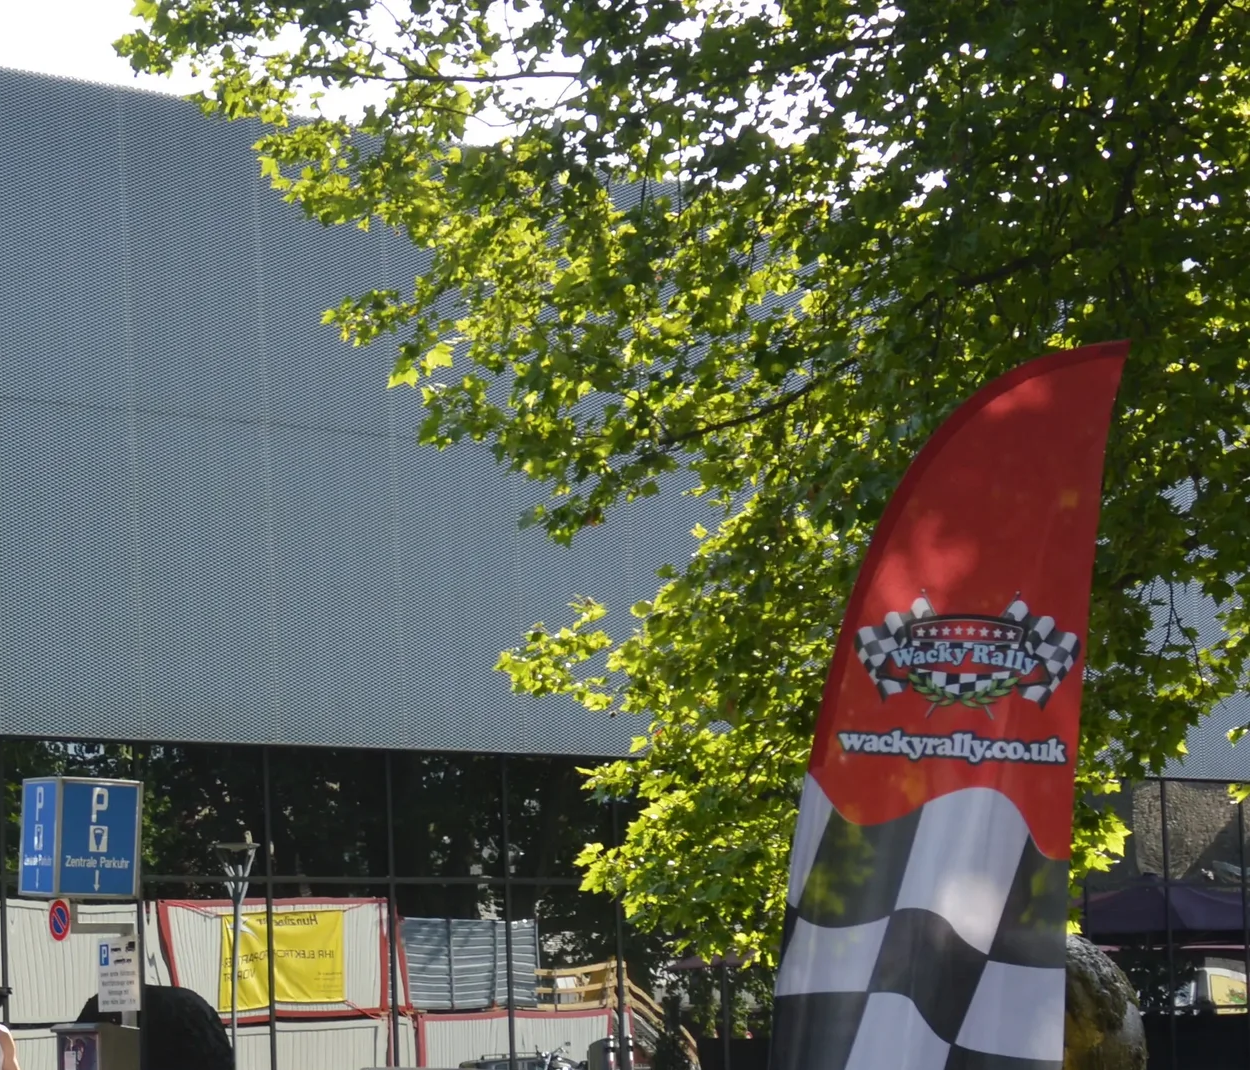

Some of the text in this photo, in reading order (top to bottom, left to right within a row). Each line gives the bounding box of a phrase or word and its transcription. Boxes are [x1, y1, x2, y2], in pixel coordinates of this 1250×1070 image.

[891, 643, 1039, 674] Wacky Rally
[838, 730, 1067, 764] wackyrally.co.uk
[91, 787, 109, 823] P
[65, 855, 97, 868] Zentrale
[99, 856, 130, 869] Parkuhr
